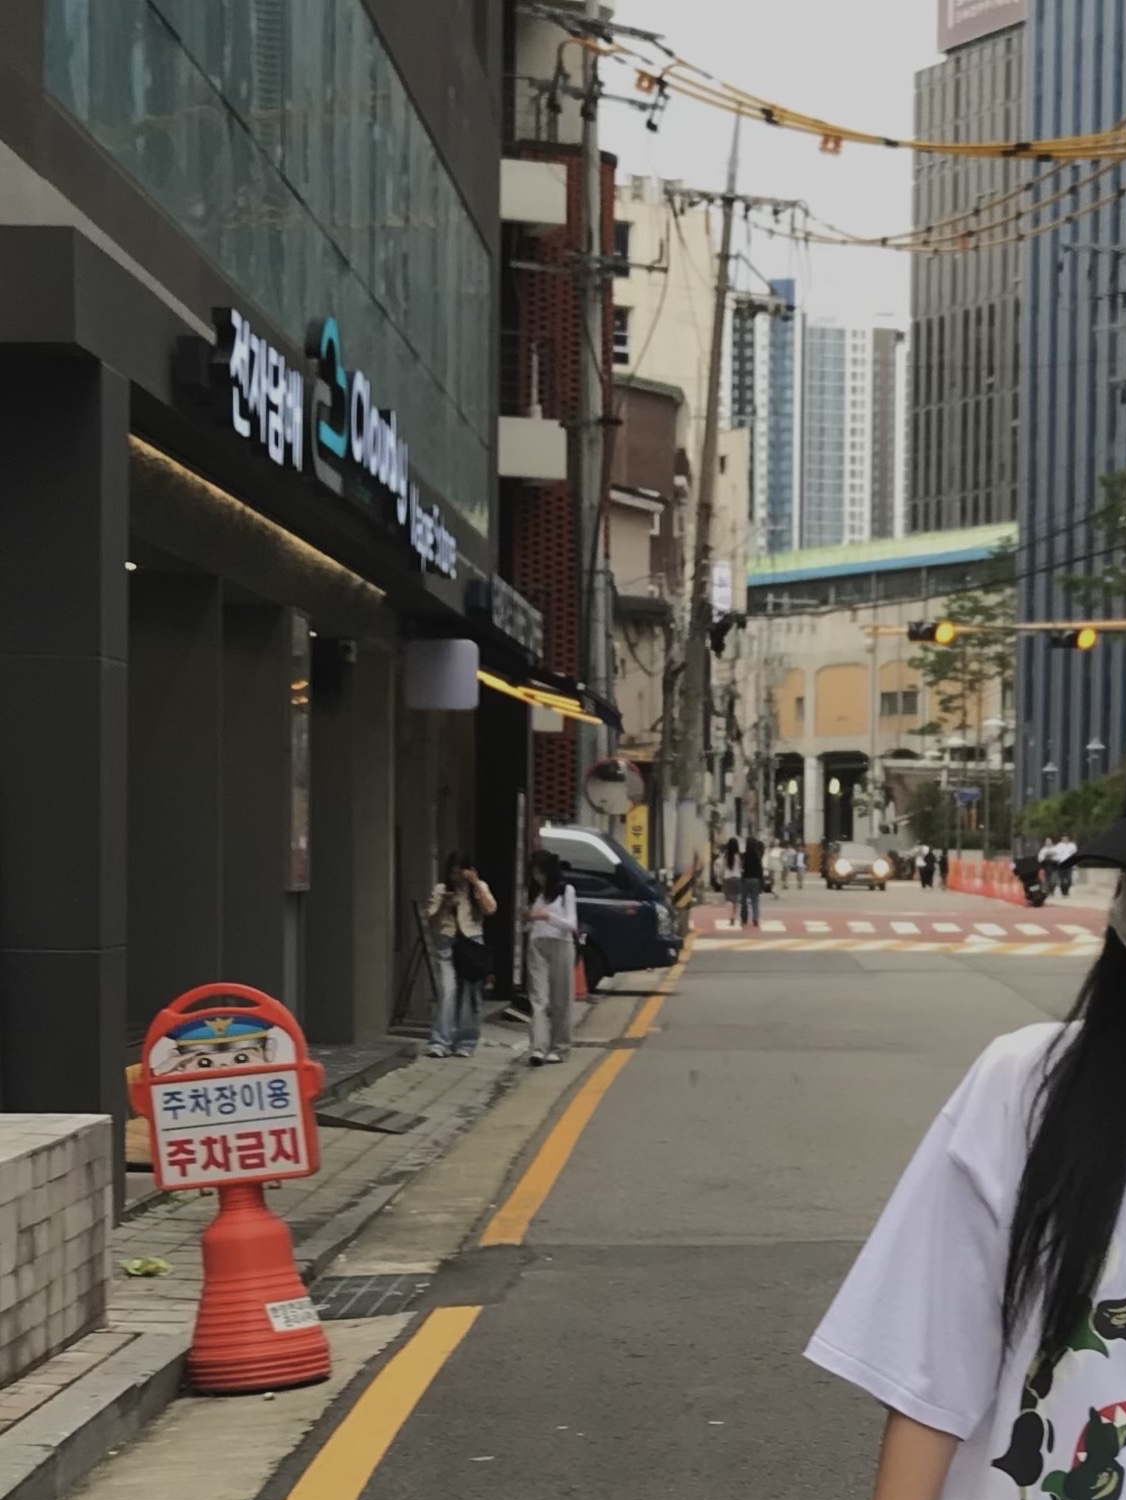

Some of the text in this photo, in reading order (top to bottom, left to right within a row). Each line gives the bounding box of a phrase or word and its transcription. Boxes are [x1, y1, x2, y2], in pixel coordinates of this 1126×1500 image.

[230, 308, 303, 472] 전자담배
[163, 1079, 290, 1119] 주차장이용
[167, 1127, 300, 1177] 주차금지
